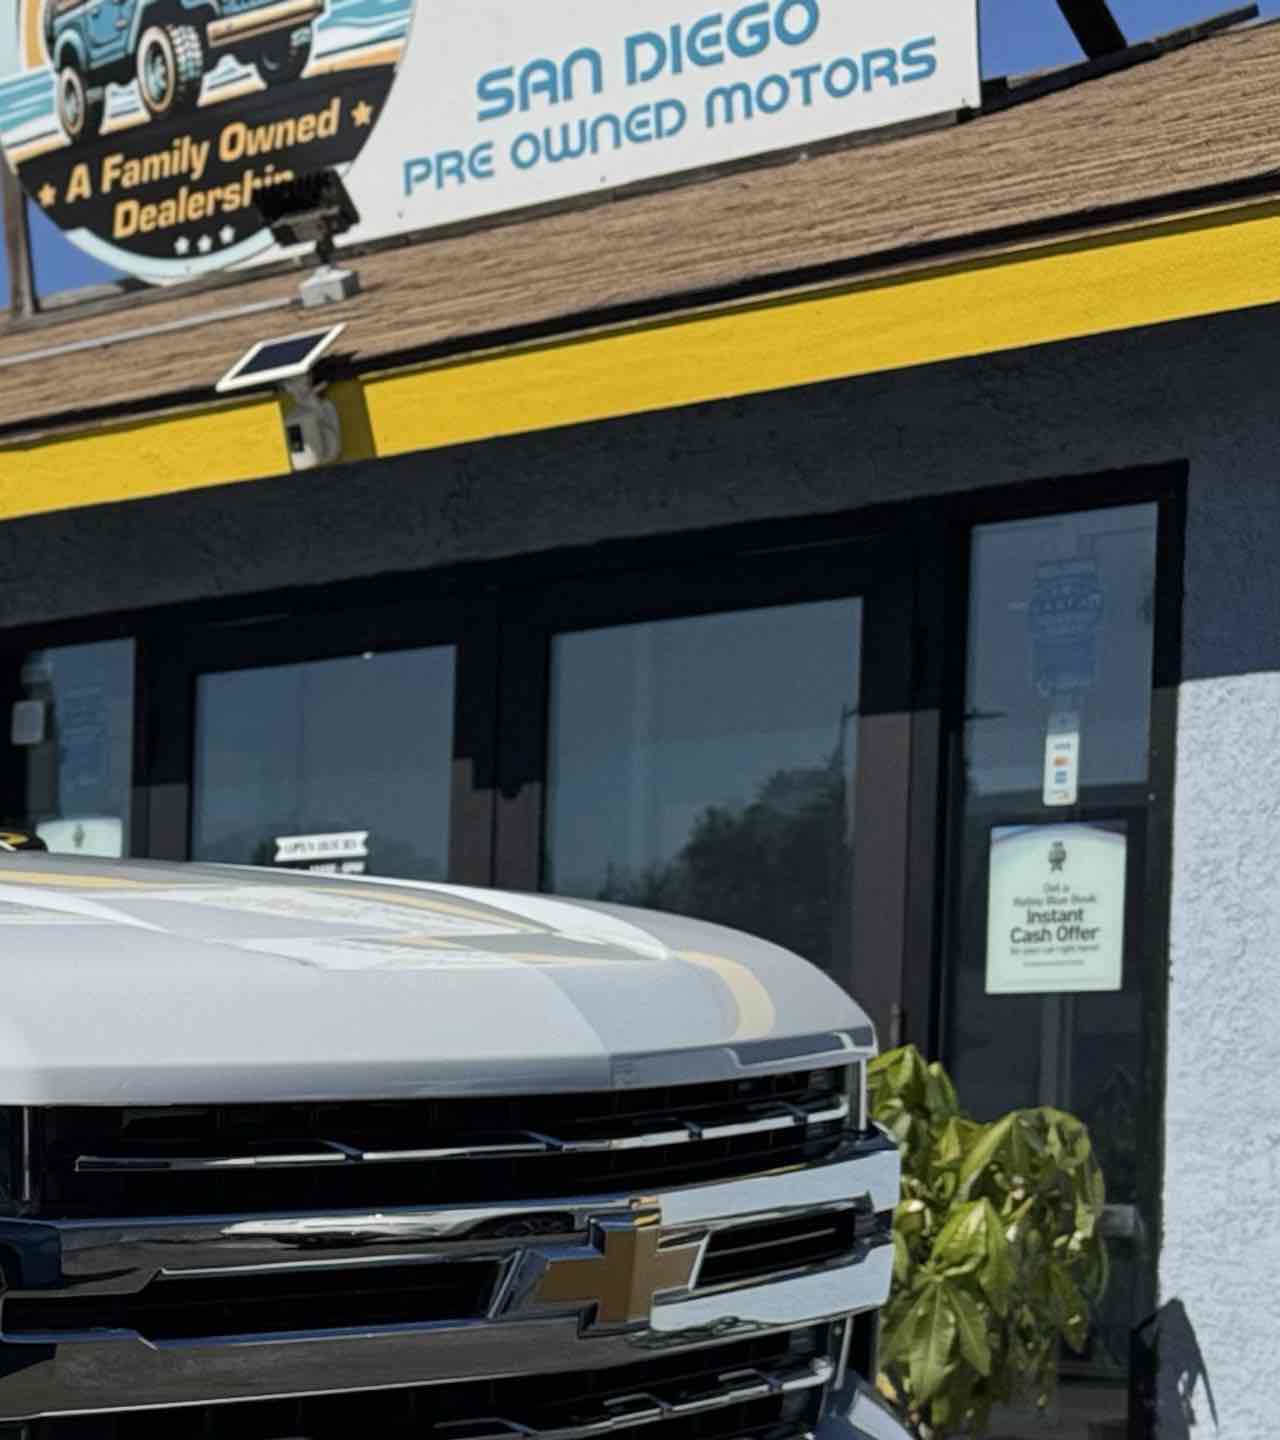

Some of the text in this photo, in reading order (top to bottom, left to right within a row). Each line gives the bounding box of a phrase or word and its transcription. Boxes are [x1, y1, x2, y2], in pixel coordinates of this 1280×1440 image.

[476, 0, 820, 121] SAN DIEGO
[65, 98, 341, 203] A Family Owned
[403, 36, 938, 197] PRE OWNED MOTORS
[1010, 926, 1052, 944] Cash
[1026, 909, 1084, 925] Instant
